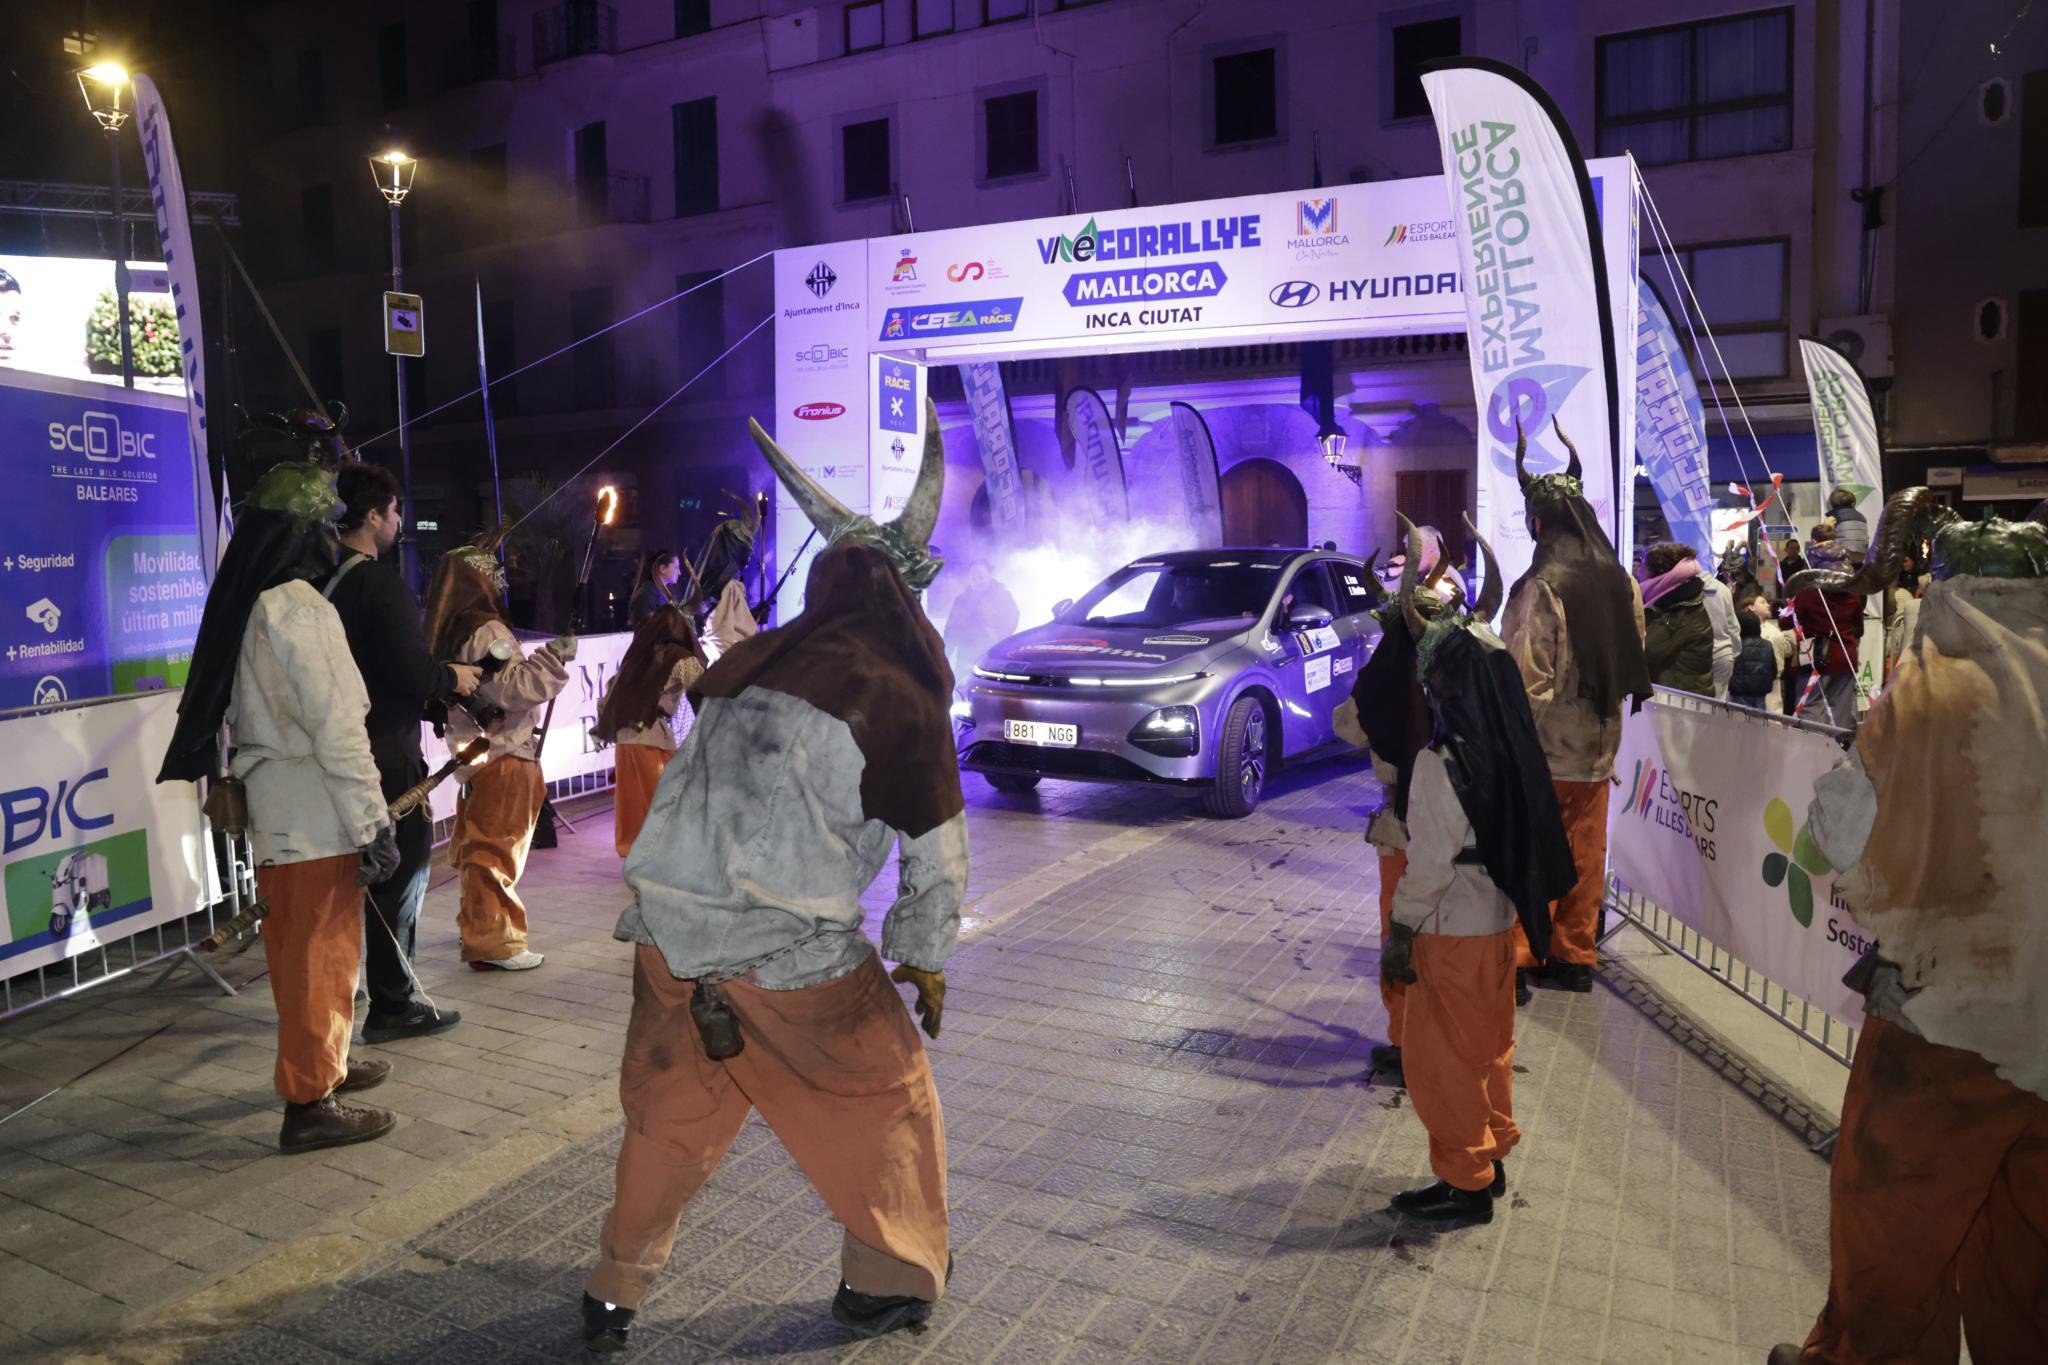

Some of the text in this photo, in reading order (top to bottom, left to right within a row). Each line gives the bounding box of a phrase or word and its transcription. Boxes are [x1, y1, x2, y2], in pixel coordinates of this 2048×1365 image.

[1287, 235, 1350, 249] MALLORCA
[1410, 234, 1428, 242] ILLES
[1076, 269, 1217, 300] MALLORCA
[784, 302, 860, 319] Ajuntament d'Inca
[1086, 306, 1203, 329] INCA CIUTAT
[980, 314, 1013, 325] RACE
[884, 375, 911, 390] RACE
[798, 406, 842, 417] Fronius
[49, 411, 156, 463] SCOBIC
[52, 465, 158, 480] THE LAST MILE SOLUTION
[76, 485, 138, 502] BALEARES
[18, 553, 75, 572] Seguridad
[129, 578, 204, 603] sostenible
[122, 610, 169, 633] última
[20, 637, 85, 659] Rentabilidad
[1048, 727, 1073, 742] NGG
[1656, 805, 1684, 834] ILLES
